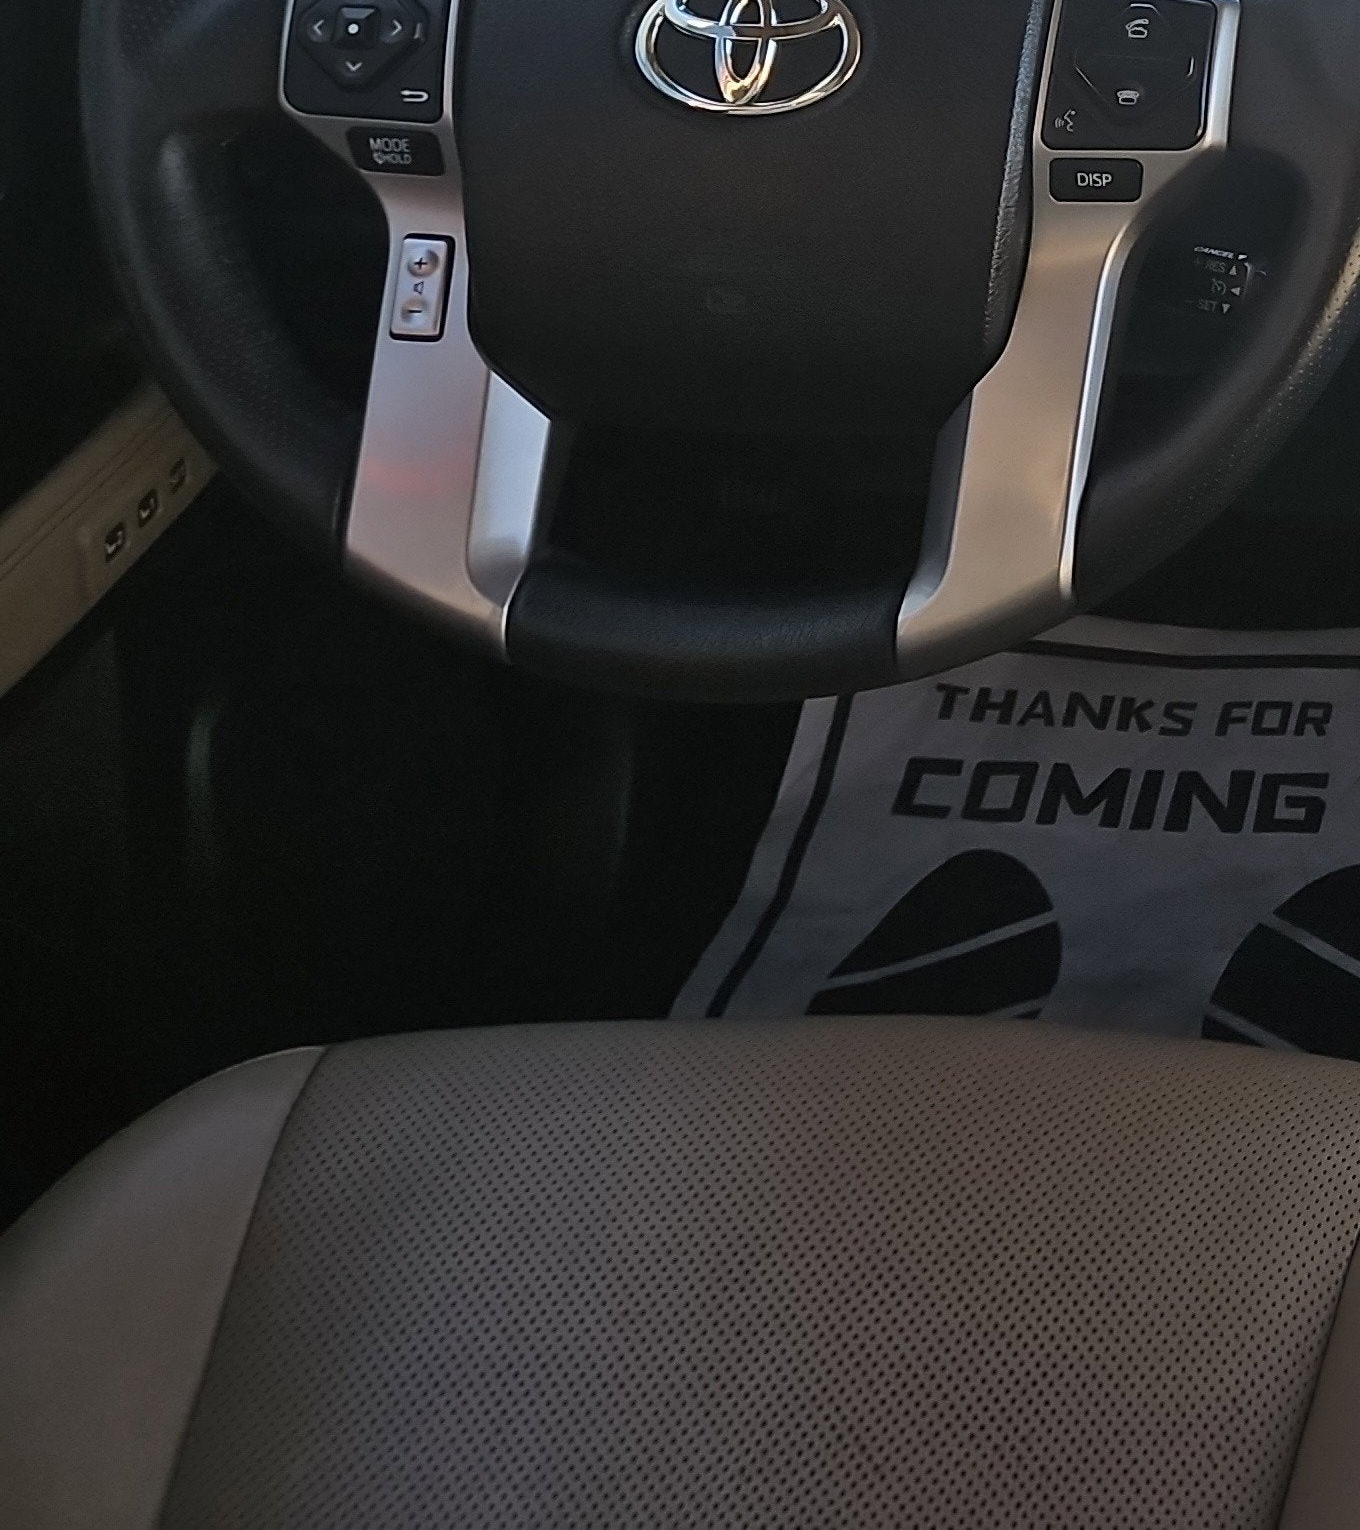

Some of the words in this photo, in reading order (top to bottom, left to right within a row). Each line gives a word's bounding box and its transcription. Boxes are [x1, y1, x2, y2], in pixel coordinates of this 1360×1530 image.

[369, 137, 411, 152] MODE
[1076, 172, 1113, 188] DISP
[934, 682, 1198, 738] THANKS
[1214, 699, 1334, 738] FOR
[889, 755, 1331, 836] COMING
